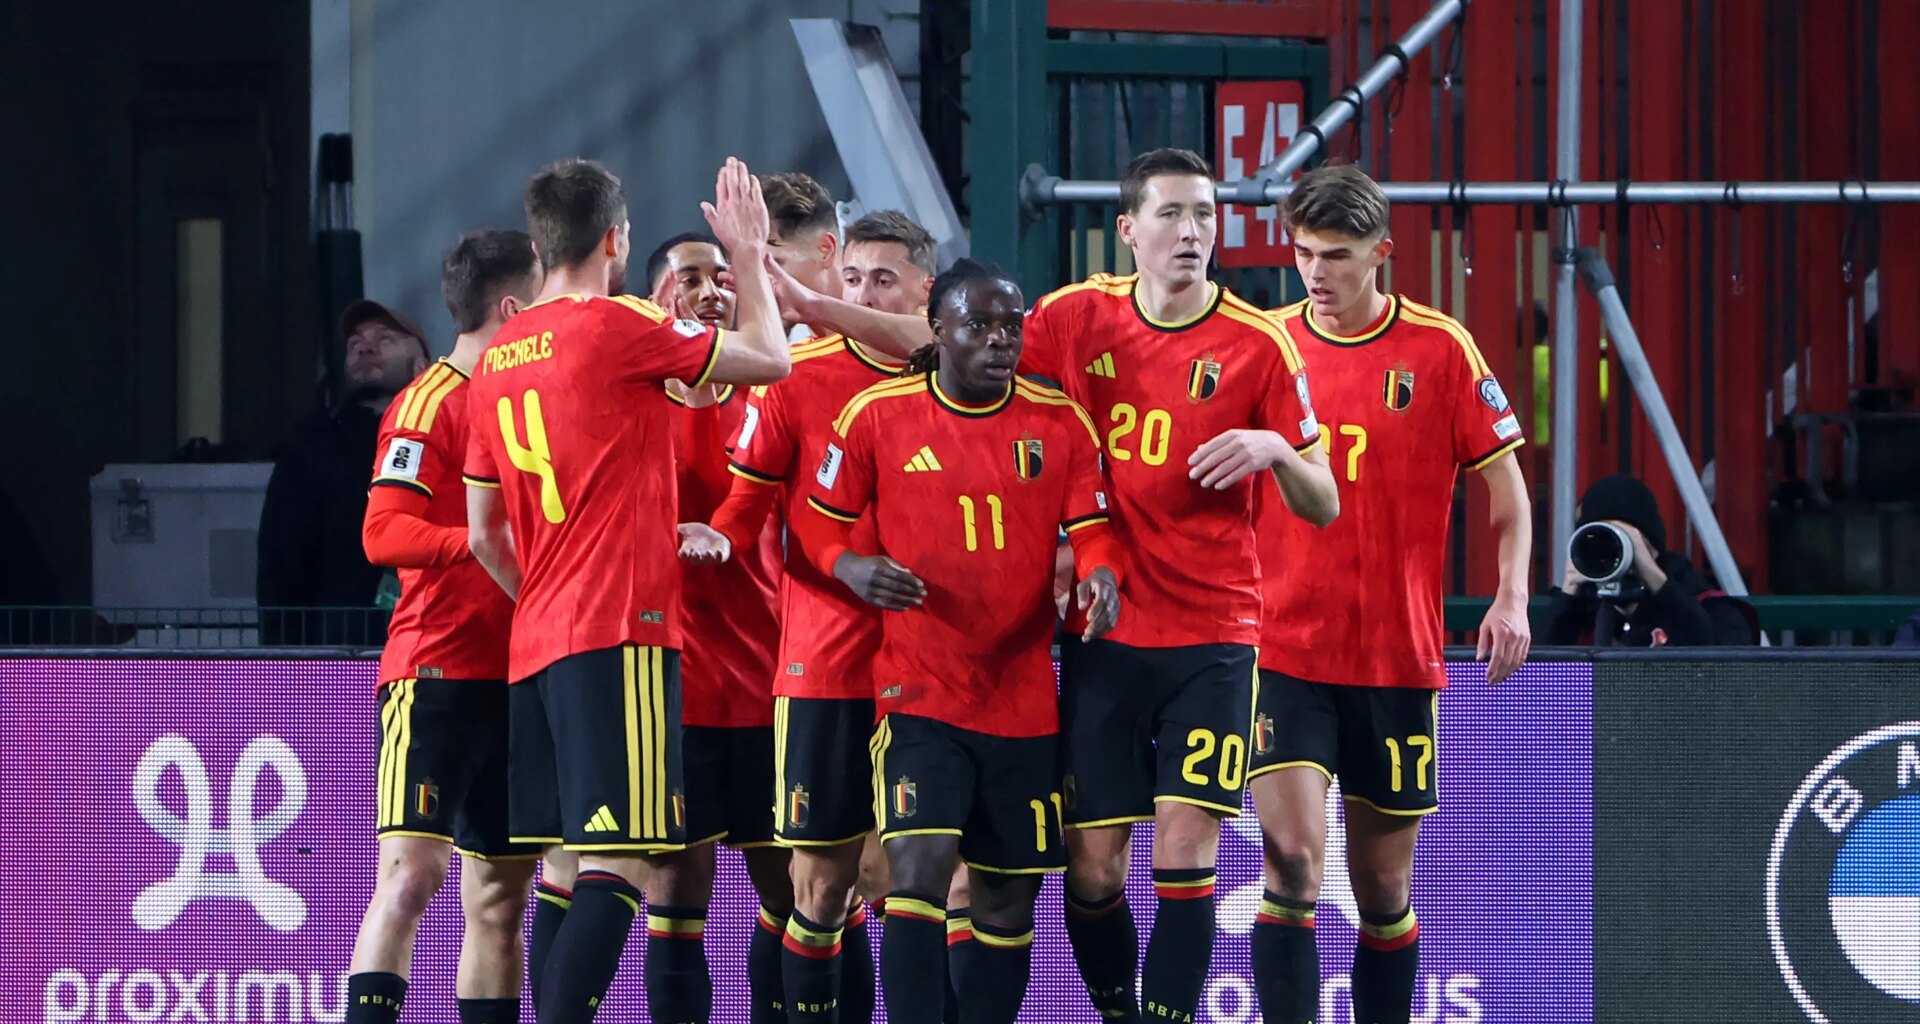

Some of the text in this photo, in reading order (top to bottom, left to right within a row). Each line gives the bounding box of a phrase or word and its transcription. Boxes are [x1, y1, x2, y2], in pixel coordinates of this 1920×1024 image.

[482, 330, 553, 376] MECHELE
[496, 388, 566, 525] 4
[1107, 402, 1172, 466] 20
[958, 494, 1005, 552] 11
[1181, 727, 1245, 791] 20
[1385, 734, 1432, 792] 17
[46, 967, 349, 1024] proximu
[1147, 1001, 1192, 1024] RBFA
